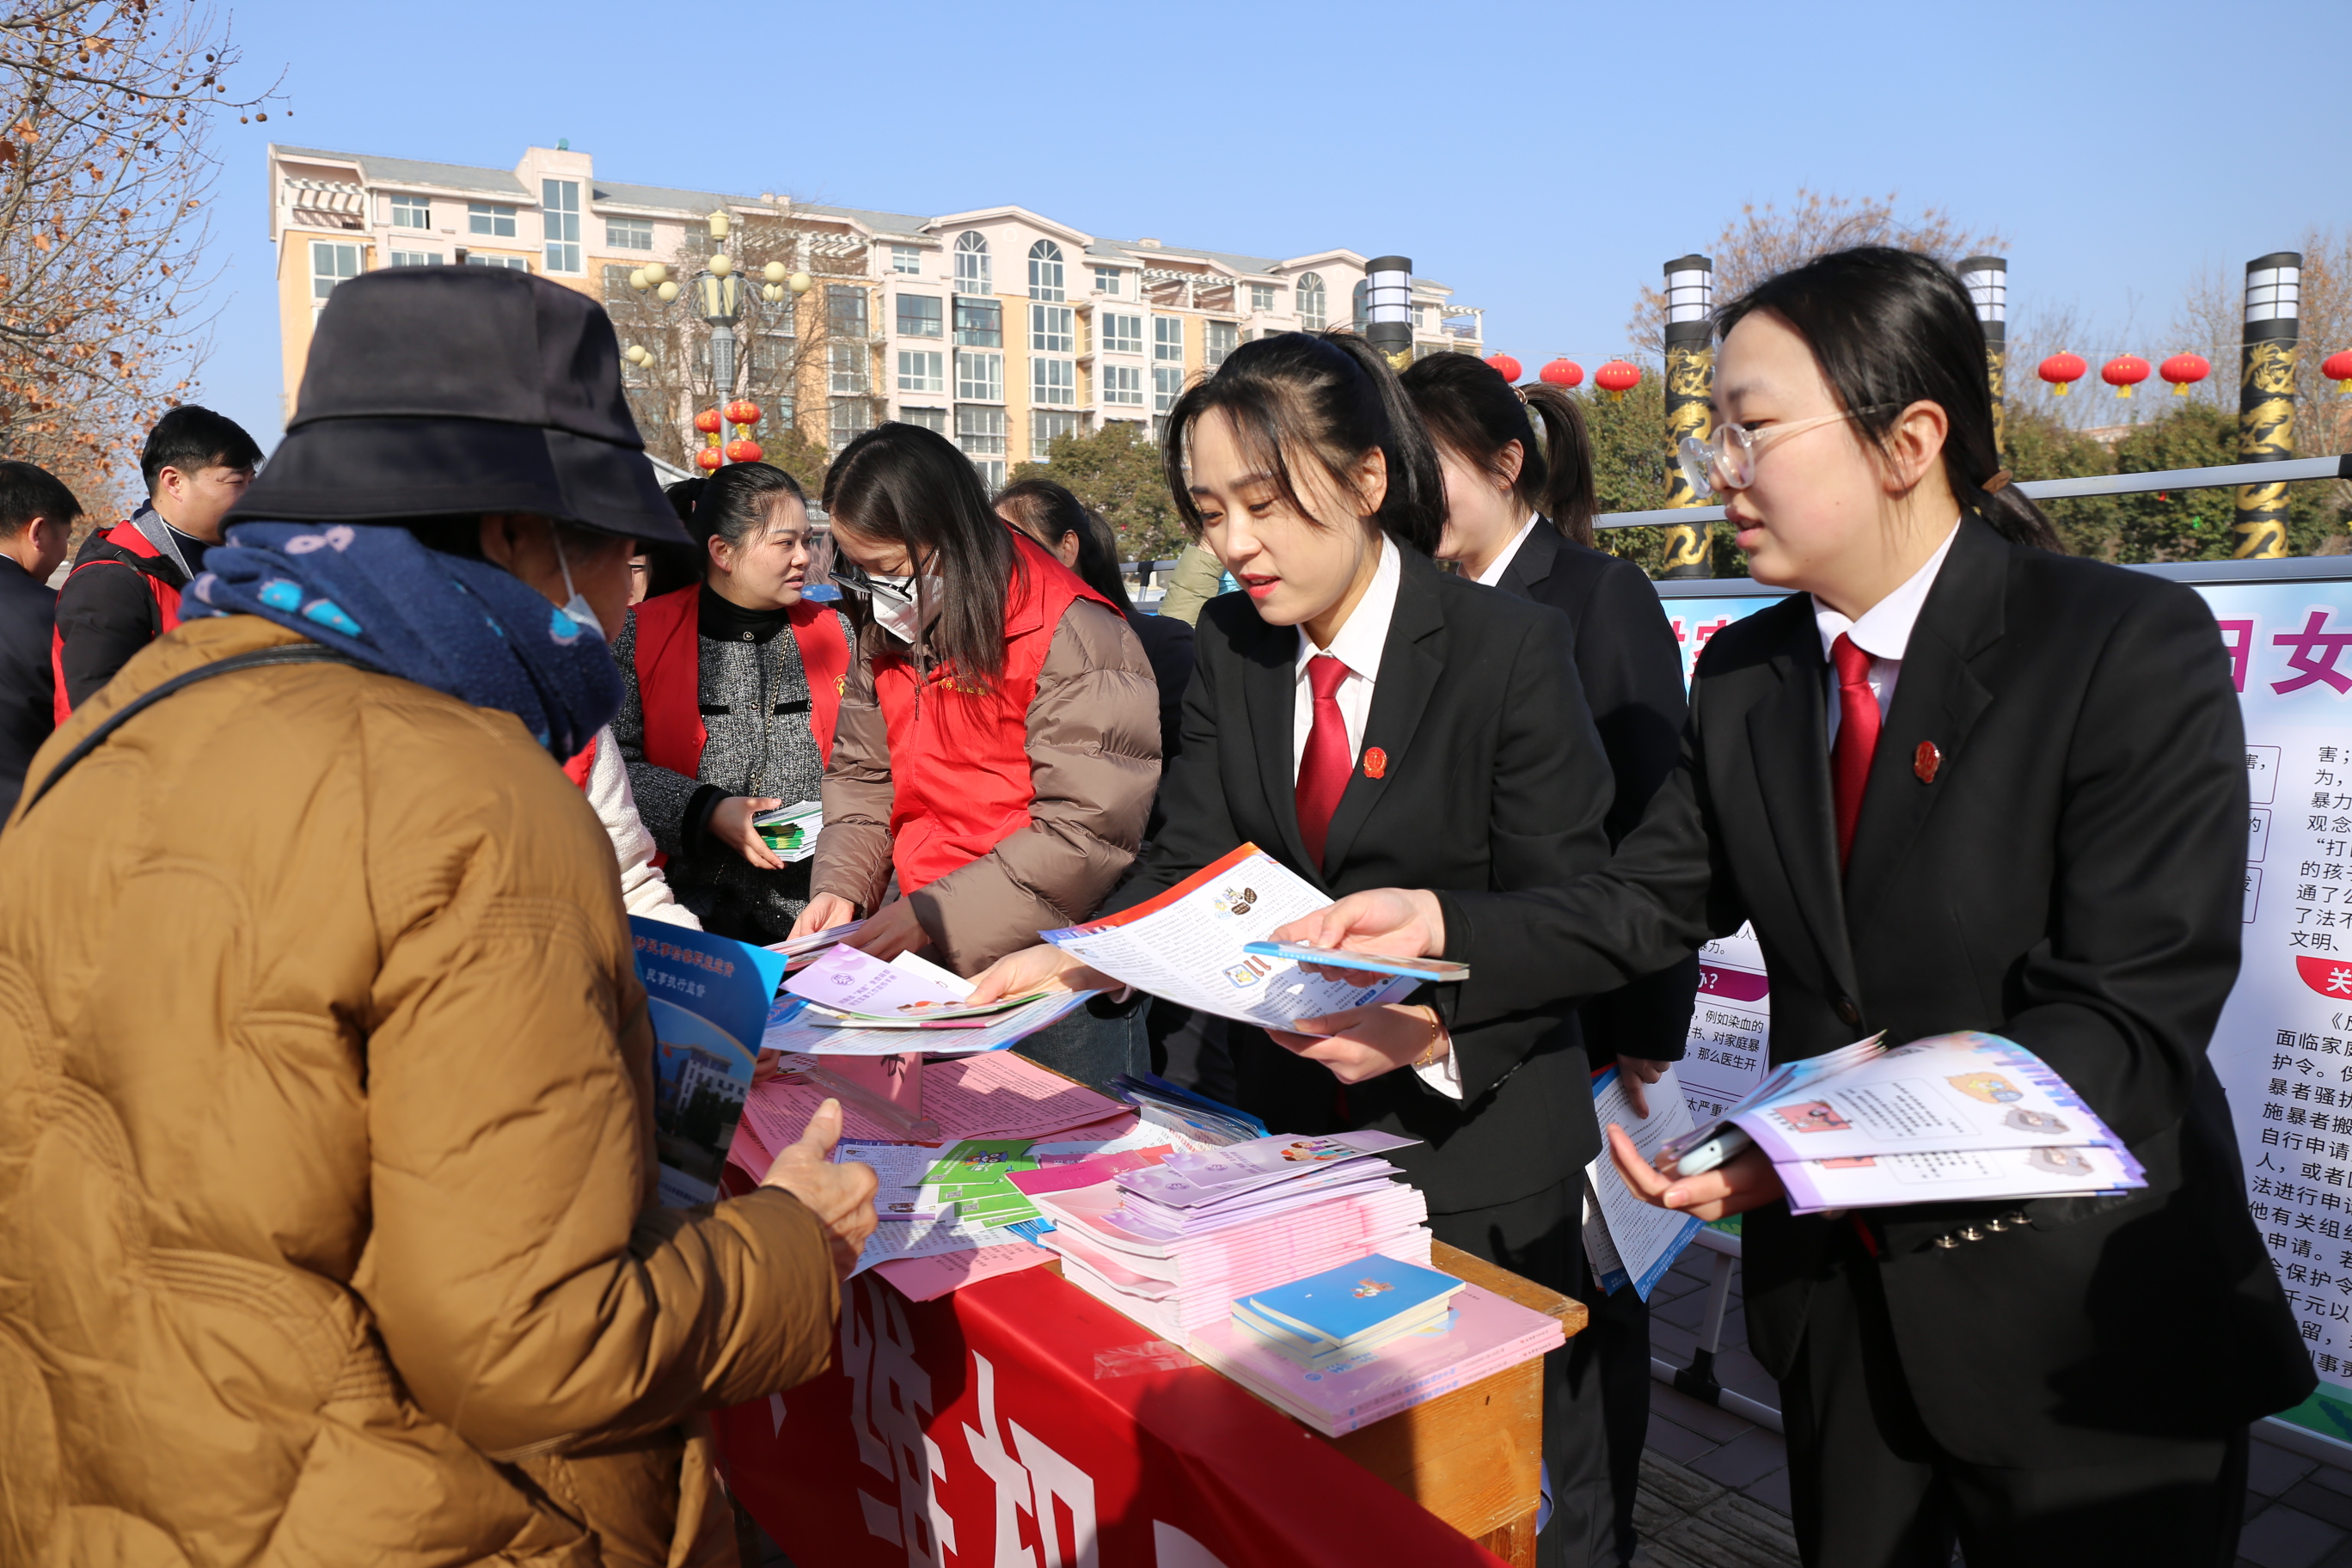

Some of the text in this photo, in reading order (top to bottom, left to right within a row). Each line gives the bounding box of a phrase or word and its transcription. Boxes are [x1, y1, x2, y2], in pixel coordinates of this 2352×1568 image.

[2314, 769, 2343, 787] 为，
[2311, 792, 2352, 811] 暴力
[2306, 815, 2352, 833] 观念
[2317, 838, 2352, 858] “打
[2288, 930, 2339, 952] 文明、
[2325, 967, 2352, 995] 关
[2256, 1152, 2352, 1187] 人，或者
